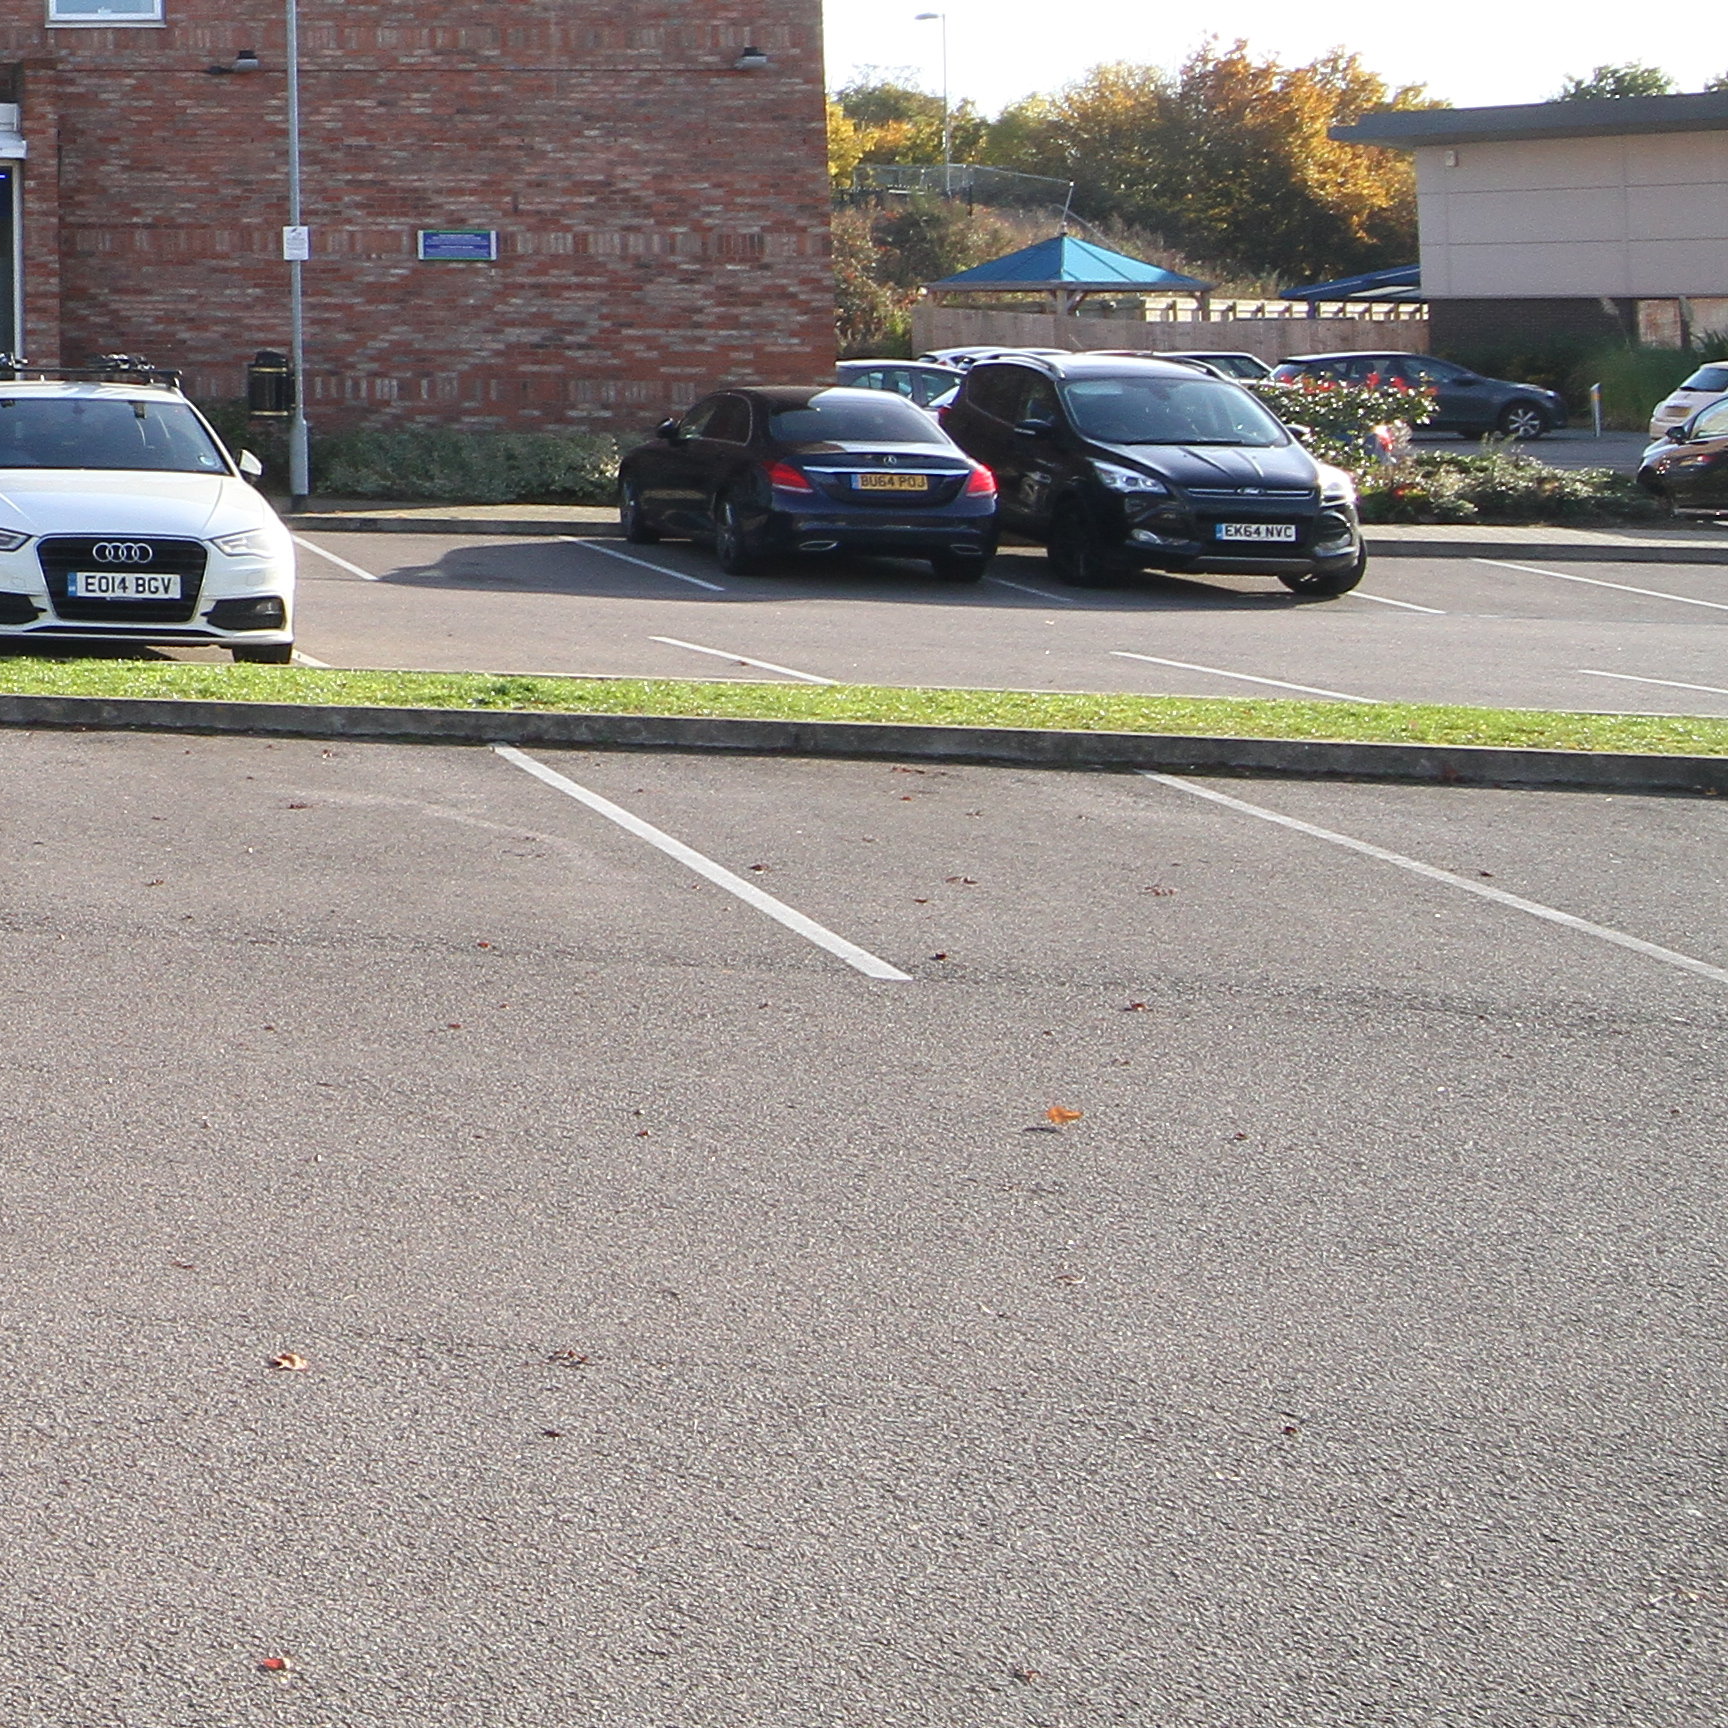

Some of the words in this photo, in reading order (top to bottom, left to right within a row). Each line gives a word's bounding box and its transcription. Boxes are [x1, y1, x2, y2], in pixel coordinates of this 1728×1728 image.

[1225, 524, 1261, 537] EK64
[1265, 525, 1293, 538] NVC
[85, 575, 129, 593] EO14
[135, 576, 172, 594] BGV
